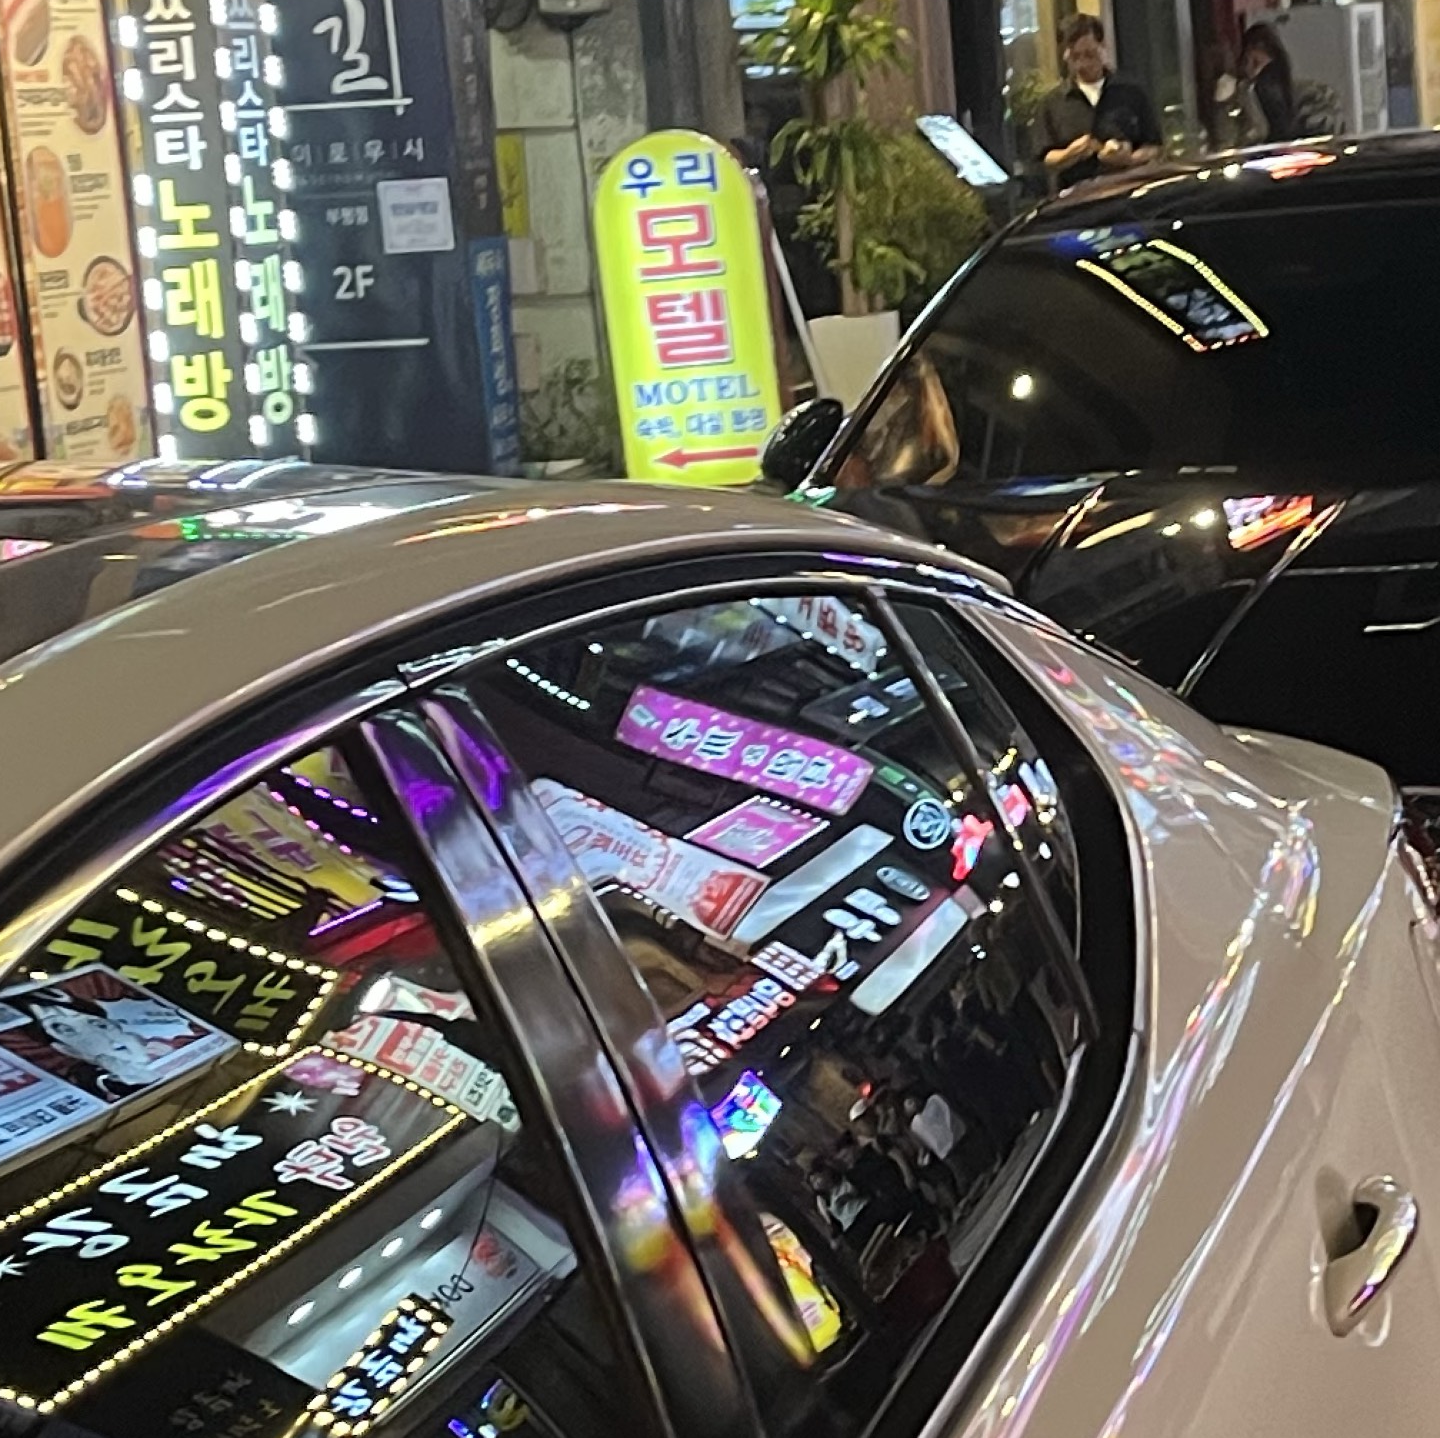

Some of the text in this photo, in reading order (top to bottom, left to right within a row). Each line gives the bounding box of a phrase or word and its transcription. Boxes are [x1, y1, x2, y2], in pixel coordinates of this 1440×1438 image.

[620, 151, 718, 198] 우리
[157, 179, 234, 434] 노래방
[241, 175, 295, 426] 노래방
[332, 264, 375, 300] 2F
[637, 204, 735, 370] 모텔
[633, 374, 761, 408] MOTEL
